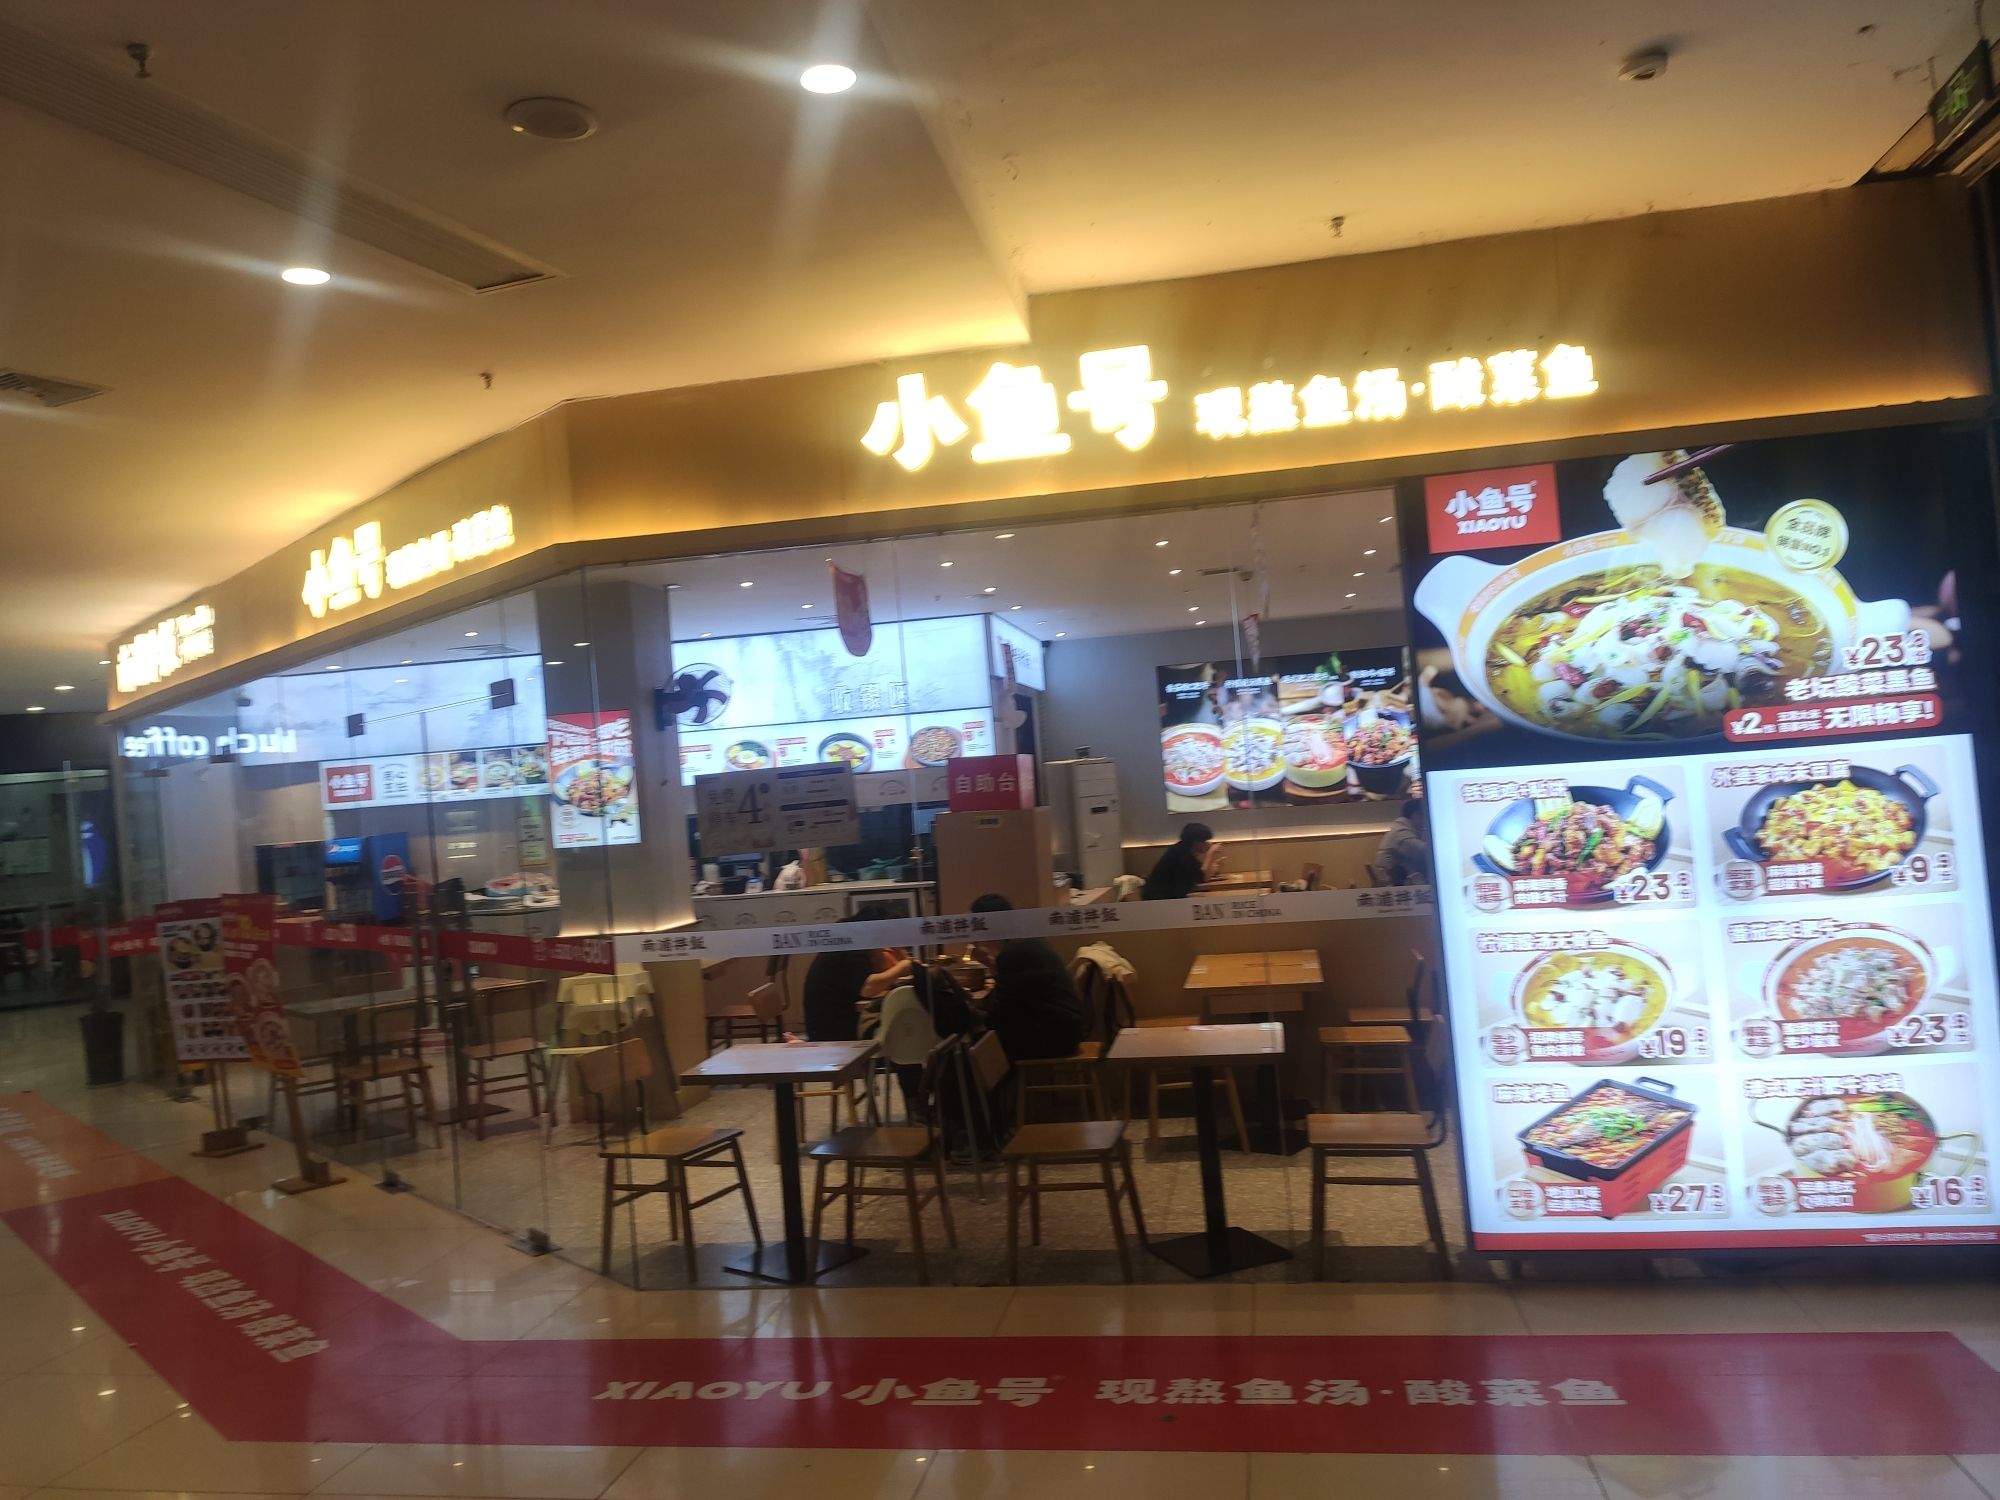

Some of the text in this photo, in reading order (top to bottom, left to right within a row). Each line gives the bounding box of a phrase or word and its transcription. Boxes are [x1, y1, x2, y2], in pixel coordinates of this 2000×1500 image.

[862, 344, 1168, 471] 小鱼号
[1444, 482, 1538, 519] 小鱼号
[1457, 515, 1527, 535] XIAOYU
[1784, 668, 1937, 701] 老坛酸菜黑鱼
[955, 772, 1017, 794] 自助台
[592, 1377, 1629, 1408] XIAOYU 小鱼号 现熬鱼汤·酸菜鱼
